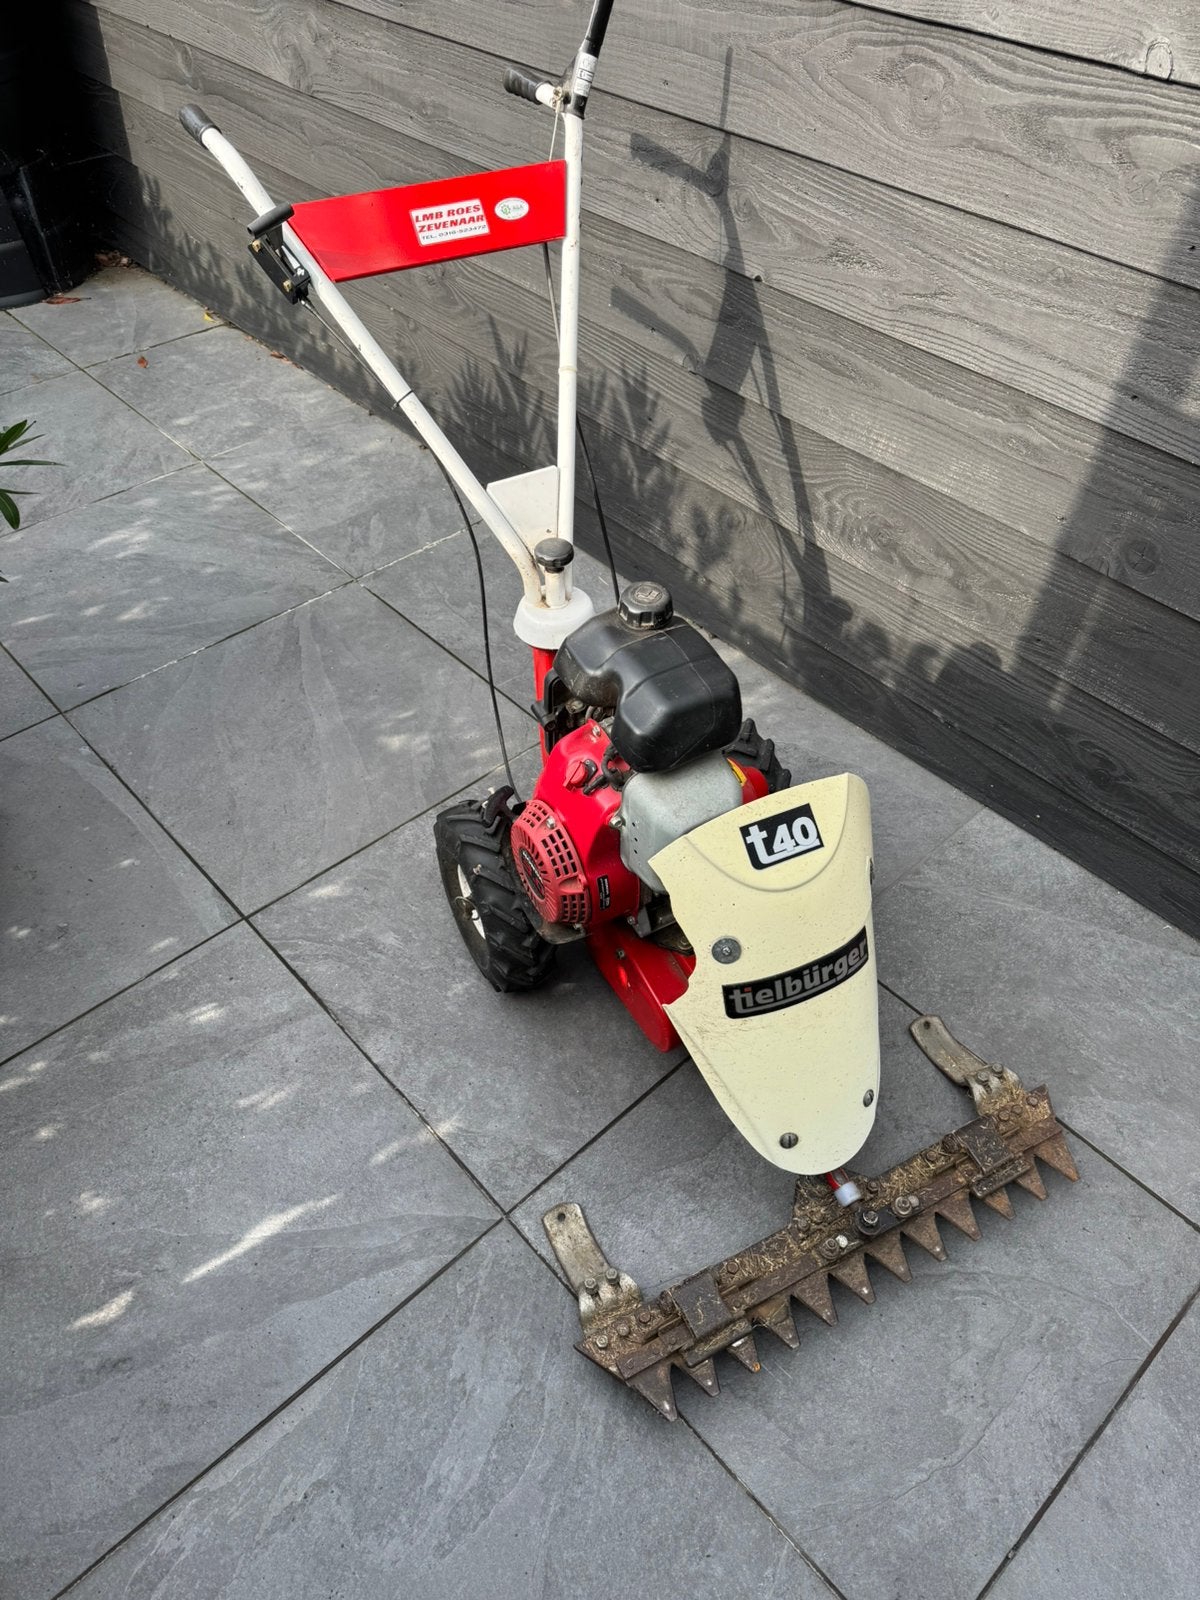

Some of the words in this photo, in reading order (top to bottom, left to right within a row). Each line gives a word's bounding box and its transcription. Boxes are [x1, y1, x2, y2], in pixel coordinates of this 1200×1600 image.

[415, 211, 443, 223] LMB
[447, 204, 481, 217] ROES
[418, 214, 485, 233] ZEVENAAR
[745, 816, 821, 865] t40
[729, 938, 867, 1014] tielbürger
